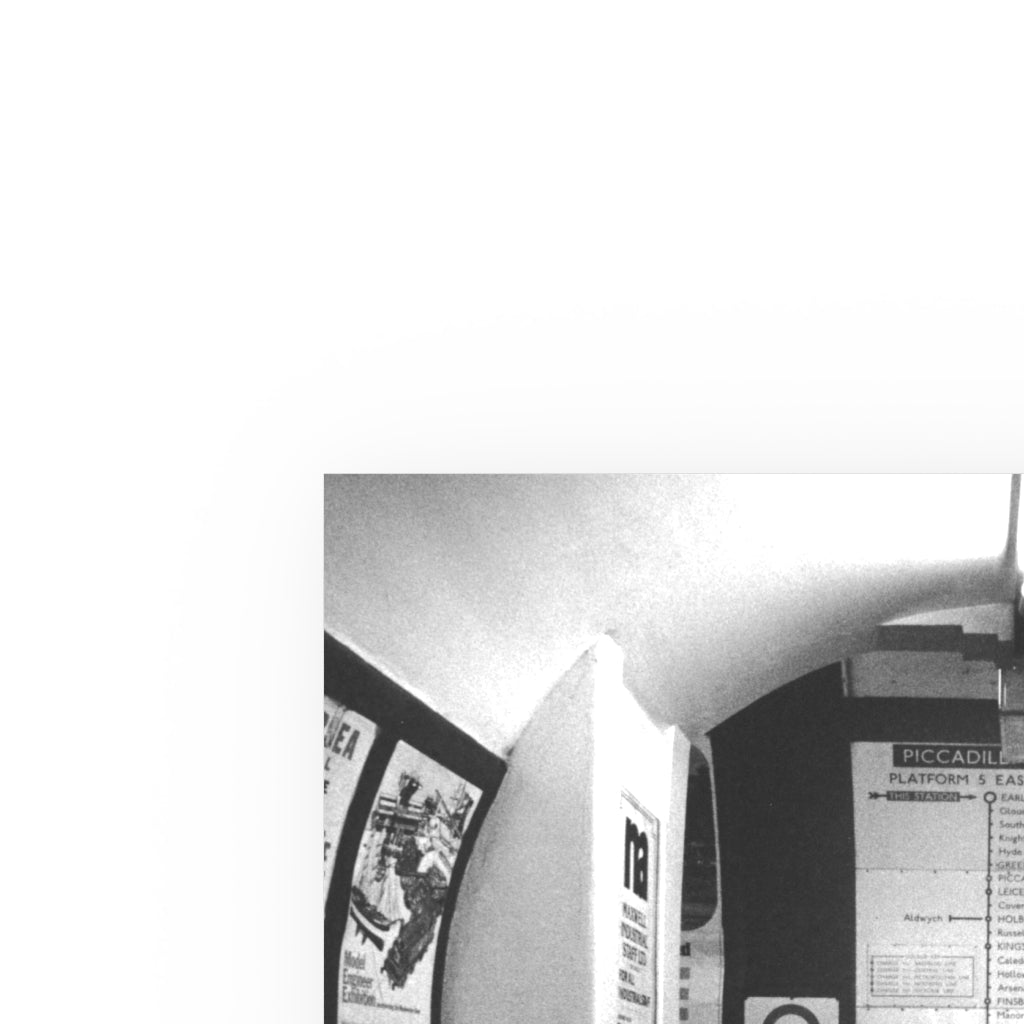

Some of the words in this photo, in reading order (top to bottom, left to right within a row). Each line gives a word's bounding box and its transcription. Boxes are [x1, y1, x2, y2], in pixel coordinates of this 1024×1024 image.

[903, 749, 1009, 765] PICCADILL
[889, 773, 969, 785] PLATFORM
[978, 774, 987, 785] 5
[889, 792, 910, 801] THIS
[914, 792, 958, 802] STATION
[1000, 820, 1024, 829] South
[999, 848, 1023, 857] Hyde
[904, 913, 943, 924] Aldwych
[344, 950, 366, 971] Model
[343, 968, 373, 989] Engineer
[997, 1011, 1024, 1020] Manor
